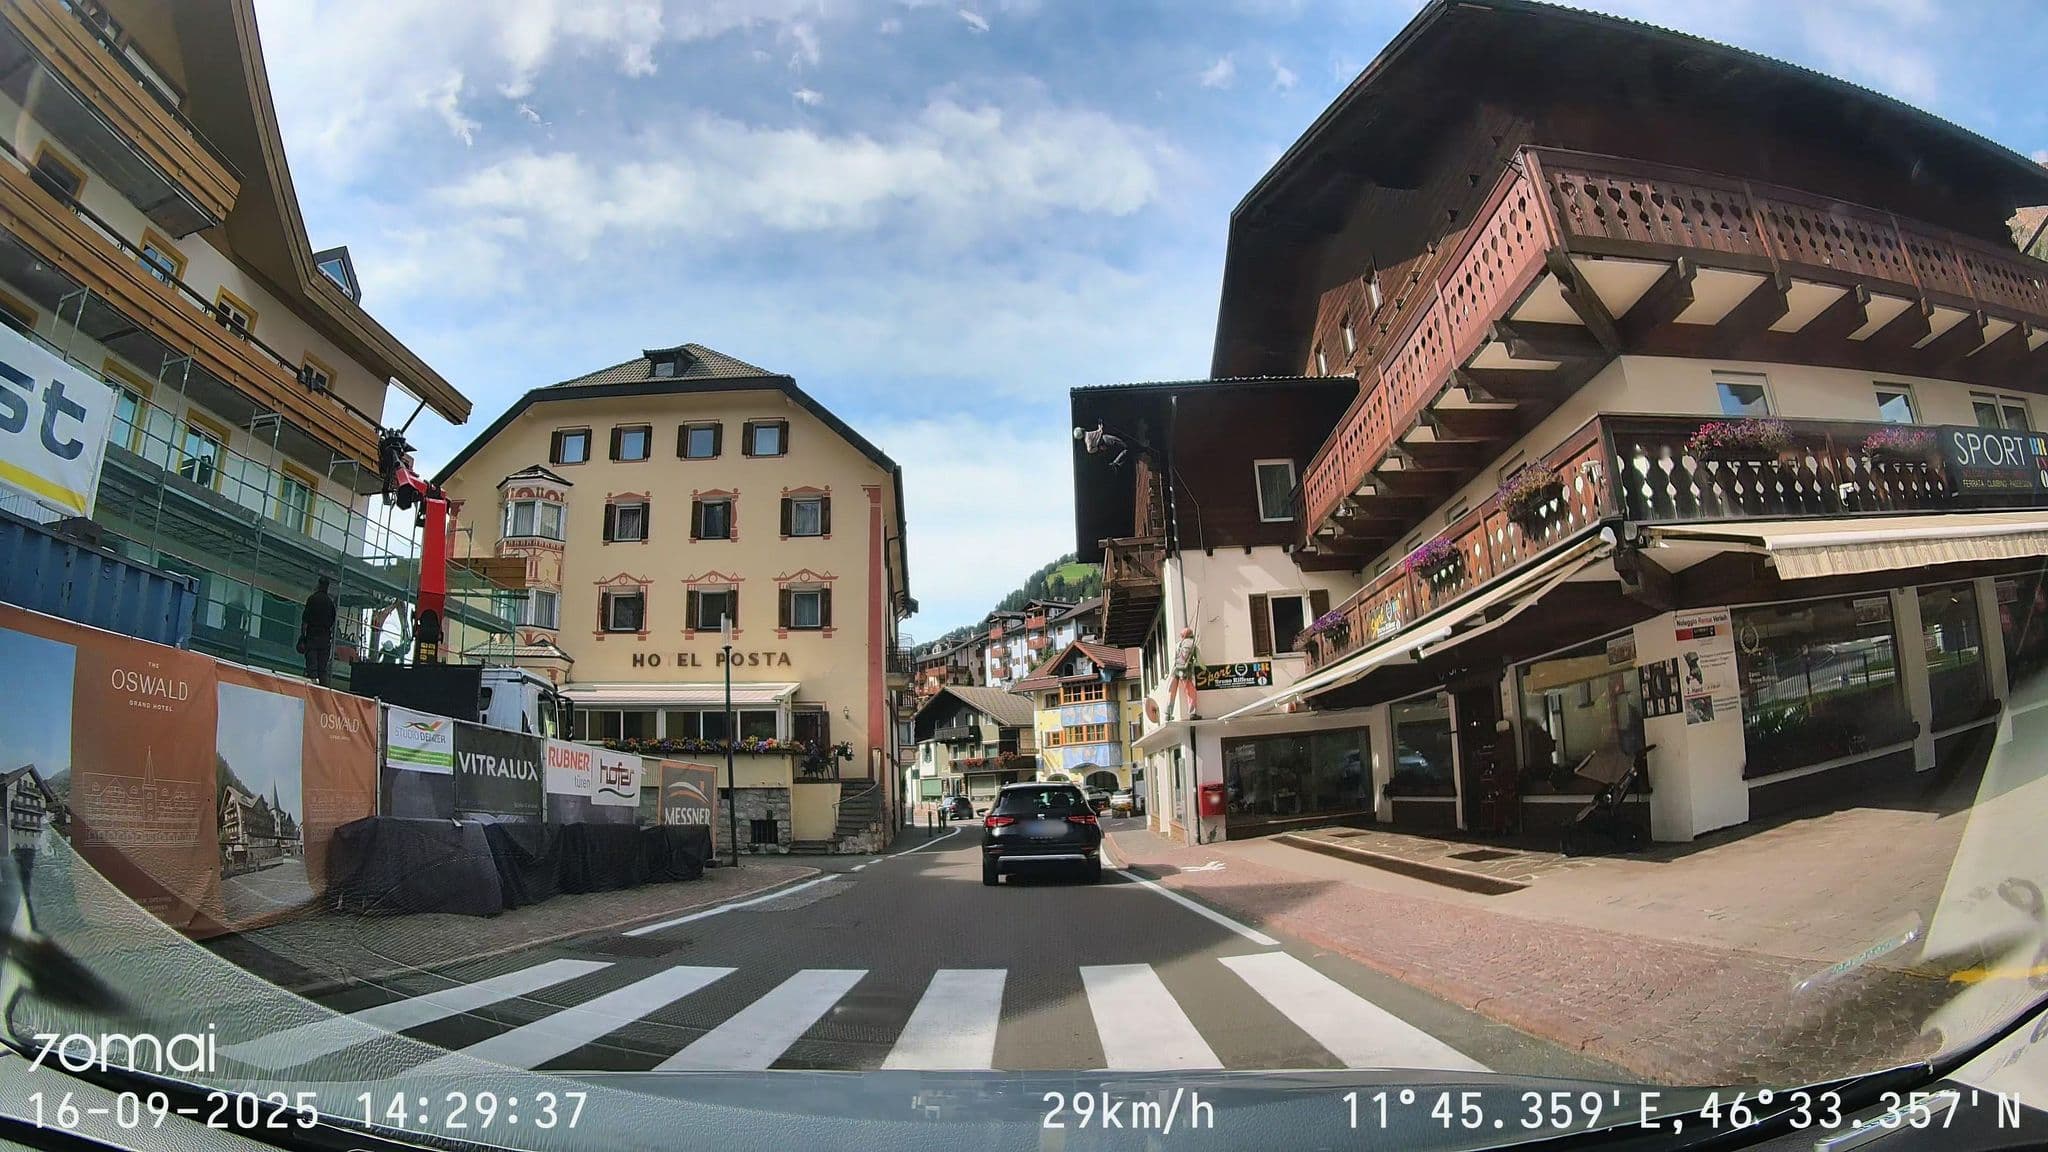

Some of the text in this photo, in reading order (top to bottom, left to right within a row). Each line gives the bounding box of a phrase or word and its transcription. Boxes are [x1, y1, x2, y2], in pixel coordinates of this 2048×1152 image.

[1953, 431, 2026, 466] SPORT
[632, 652, 792, 668] HOEL POSTA
[111, 668, 189, 701] OSWALD
[128, 699, 174, 712] GRAND HOTEL
[320, 712, 360, 733] OSWALD
[457, 751, 538, 782] VITRALUX
[548, 747, 590, 773] RUBNER
[664, 807, 711, 826] MESSNER
